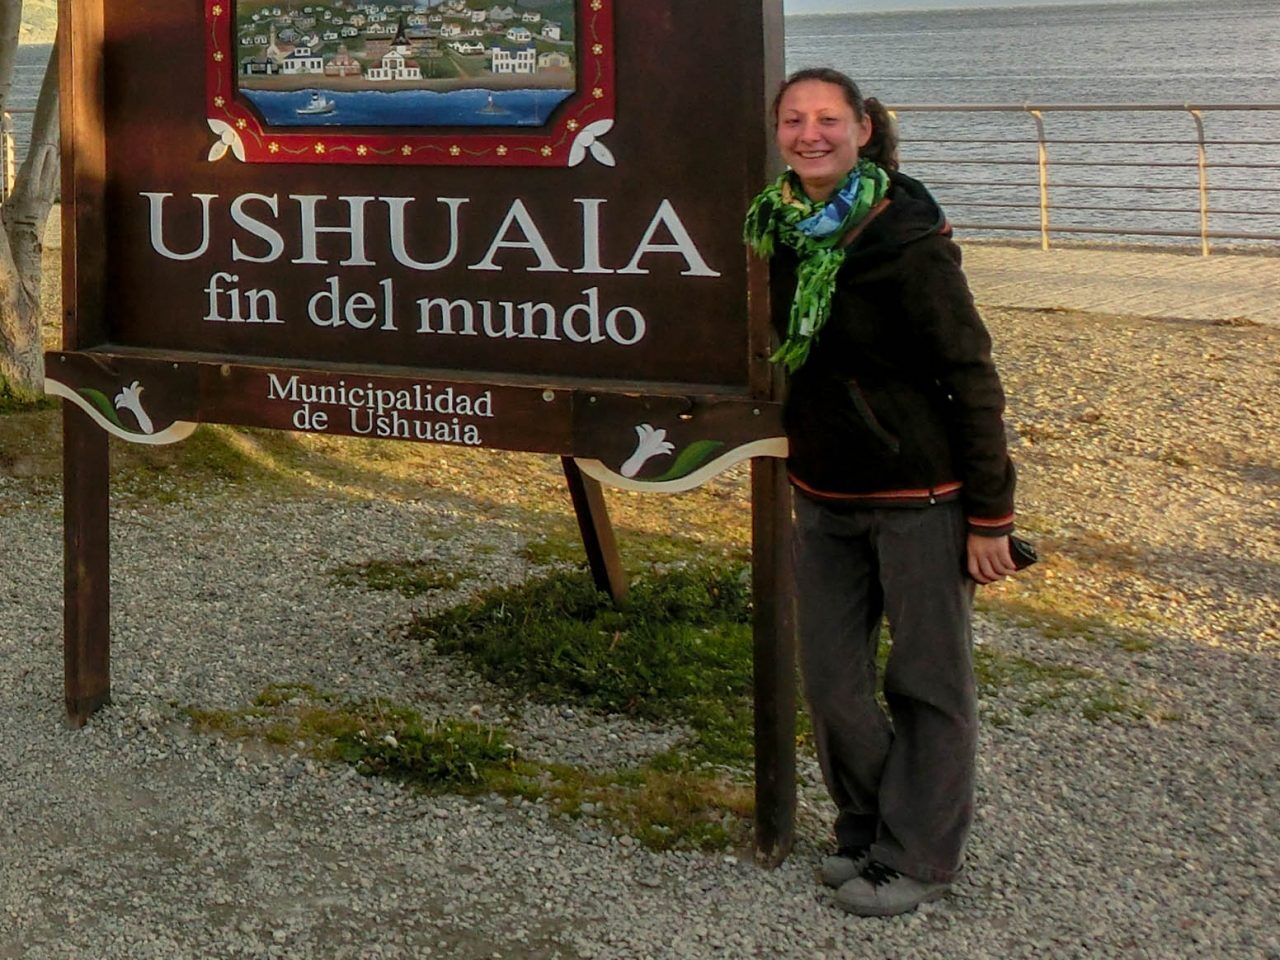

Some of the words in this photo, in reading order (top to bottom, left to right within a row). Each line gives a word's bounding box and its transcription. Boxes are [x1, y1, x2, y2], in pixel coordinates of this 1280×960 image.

[138, 192, 721, 277] USHUAIA
[203, 272, 285, 323] fin
[307, 275, 398, 331] del
[416, 286, 646, 345] mundo
[267, 373, 494, 417] Municipalidad
[293, 404, 328, 430] de
[348, 407, 482, 445] Ushuaia
